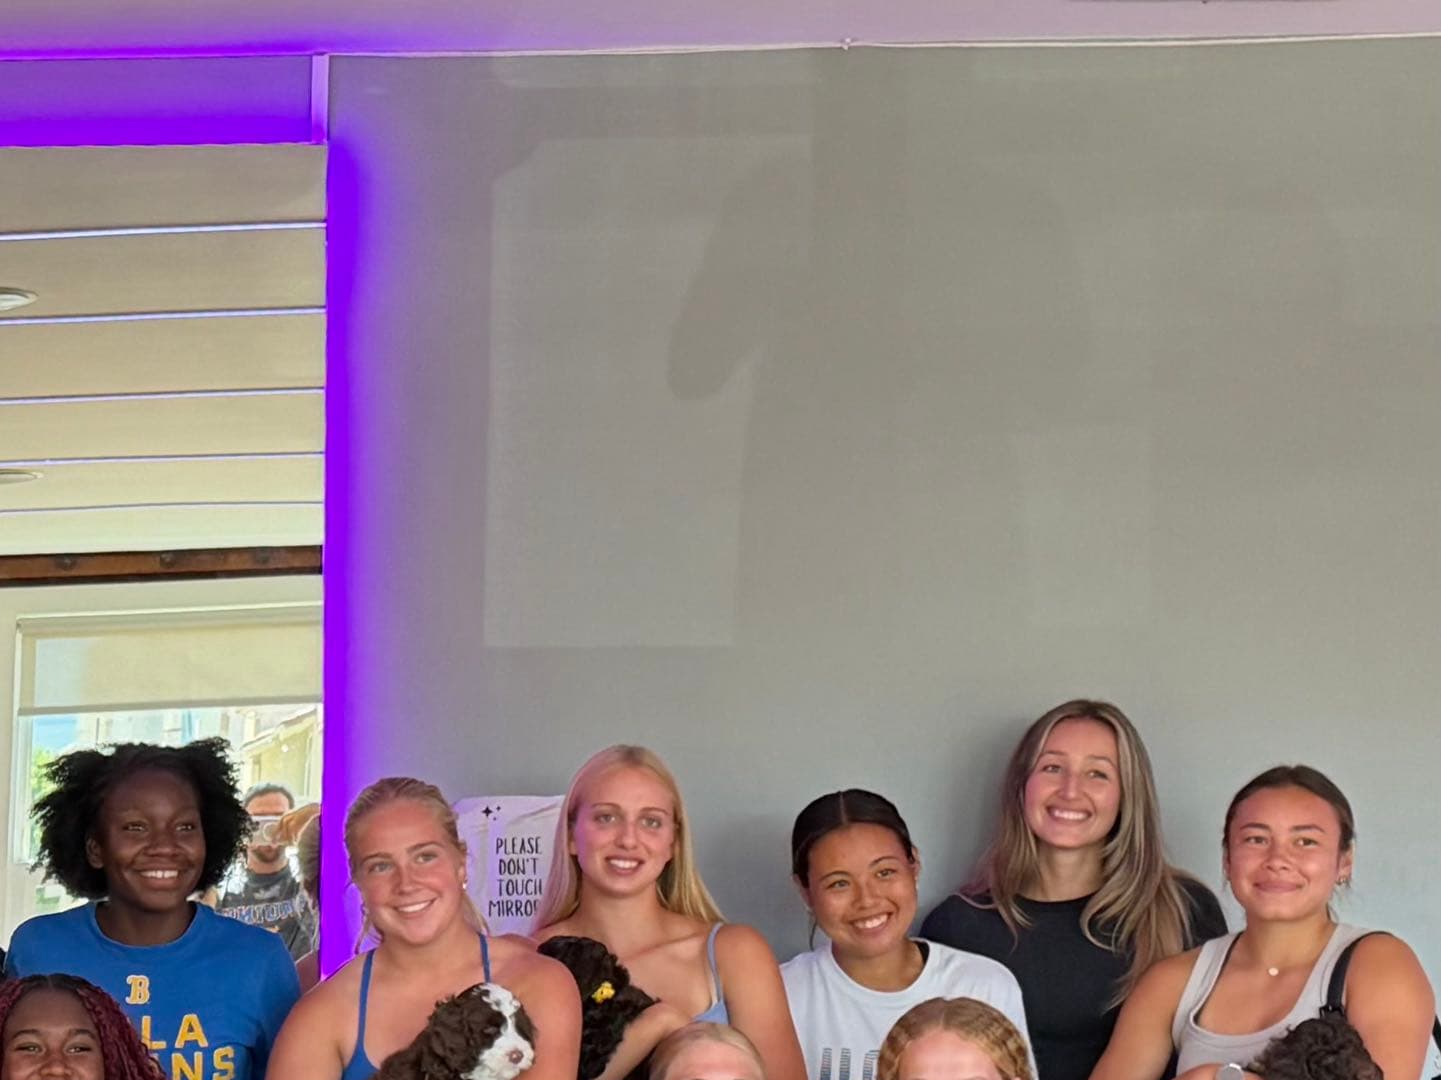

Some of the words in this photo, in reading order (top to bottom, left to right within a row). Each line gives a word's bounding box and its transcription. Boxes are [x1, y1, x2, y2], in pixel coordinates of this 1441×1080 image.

[495, 837, 543, 855] PLEASE
[498, 858, 539, 876] DON'T
[497, 878, 543, 897] TOUCH
[125, 975, 150, 1004] B
